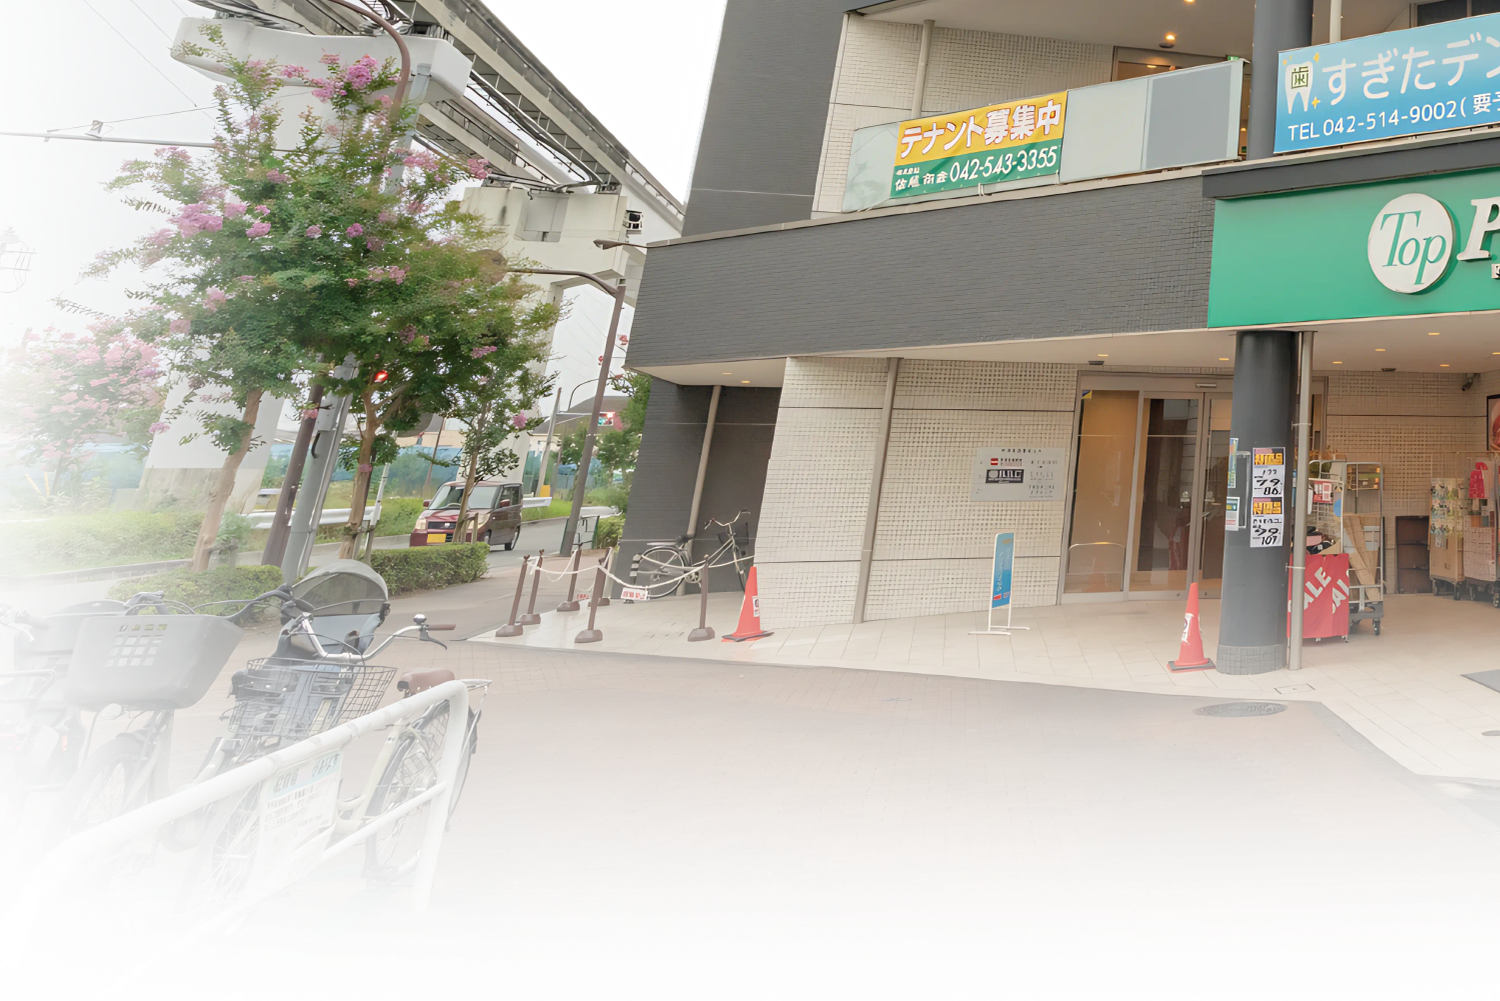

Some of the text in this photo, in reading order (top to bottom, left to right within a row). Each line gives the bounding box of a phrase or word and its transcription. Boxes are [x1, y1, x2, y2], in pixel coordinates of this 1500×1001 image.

[900, 99, 1062, 159] テナント募集中
[1288, 121, 1320, 141] TEL
[949, 146, 1058, 183] 042-543-3355
[1380, 210, 1446, 285] Top
